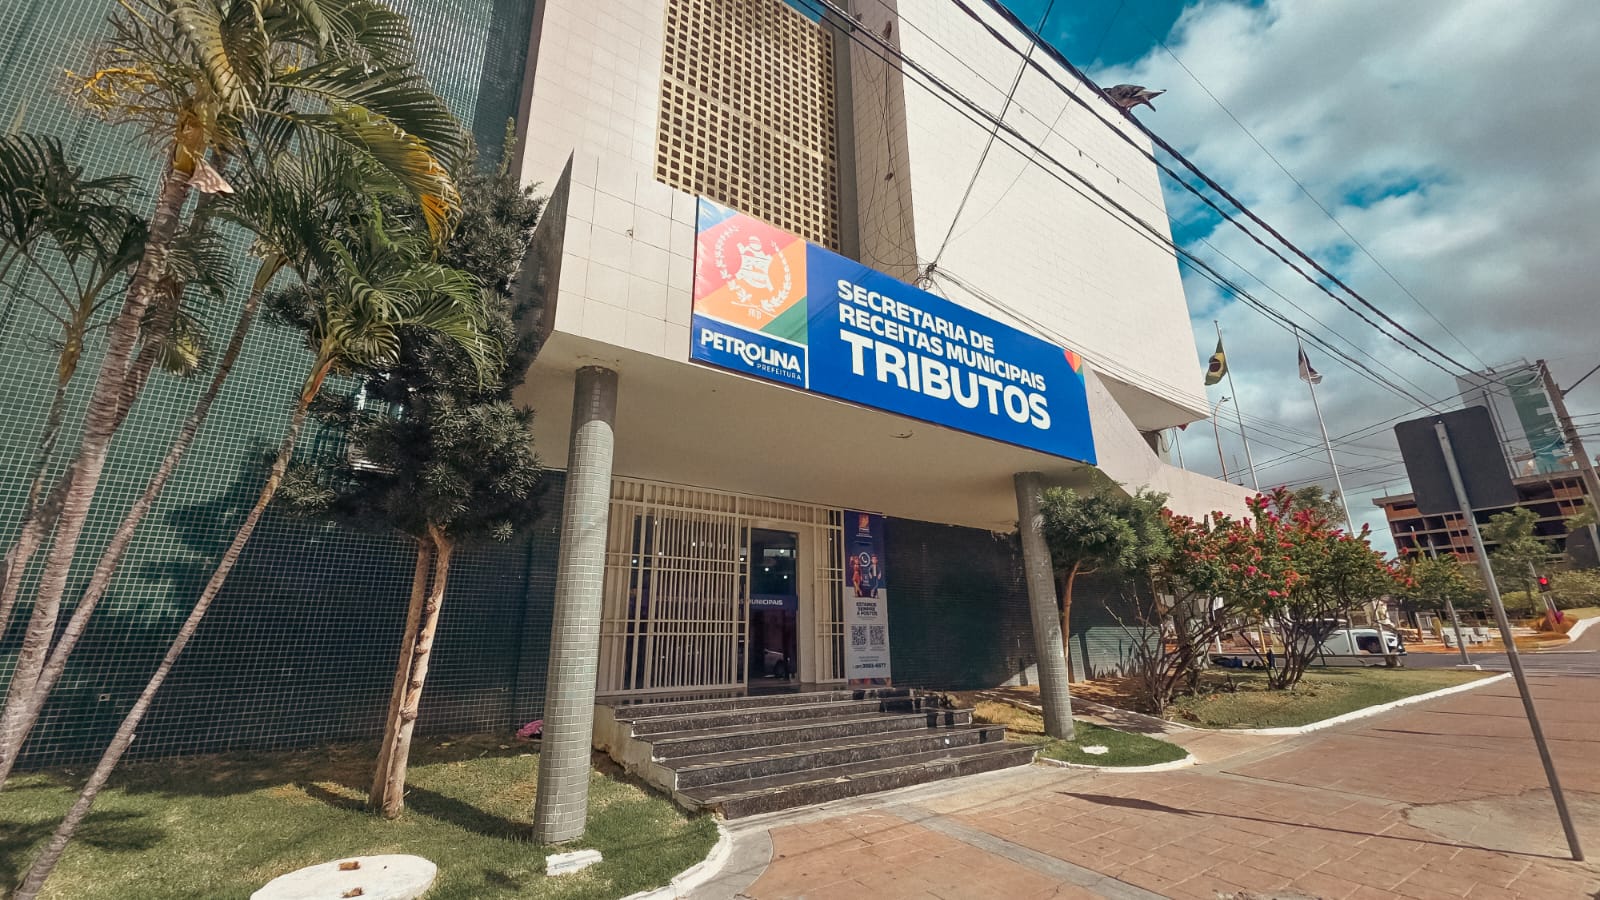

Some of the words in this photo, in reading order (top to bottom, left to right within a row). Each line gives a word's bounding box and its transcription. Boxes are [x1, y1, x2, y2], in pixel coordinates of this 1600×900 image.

[701, 328, 801, 373] PETROLINA
[838, 279, 969, 345] SECRETARIA
[970, 330, 995, 354] DE
[839, 302, 944, 356] RECEITAS
[946, 341, 1047, 392] MUNICIPAIS
[756, 363, 802, 381] PREFEITURA
[840, 329, 1051, 430] TRIBUTOS
